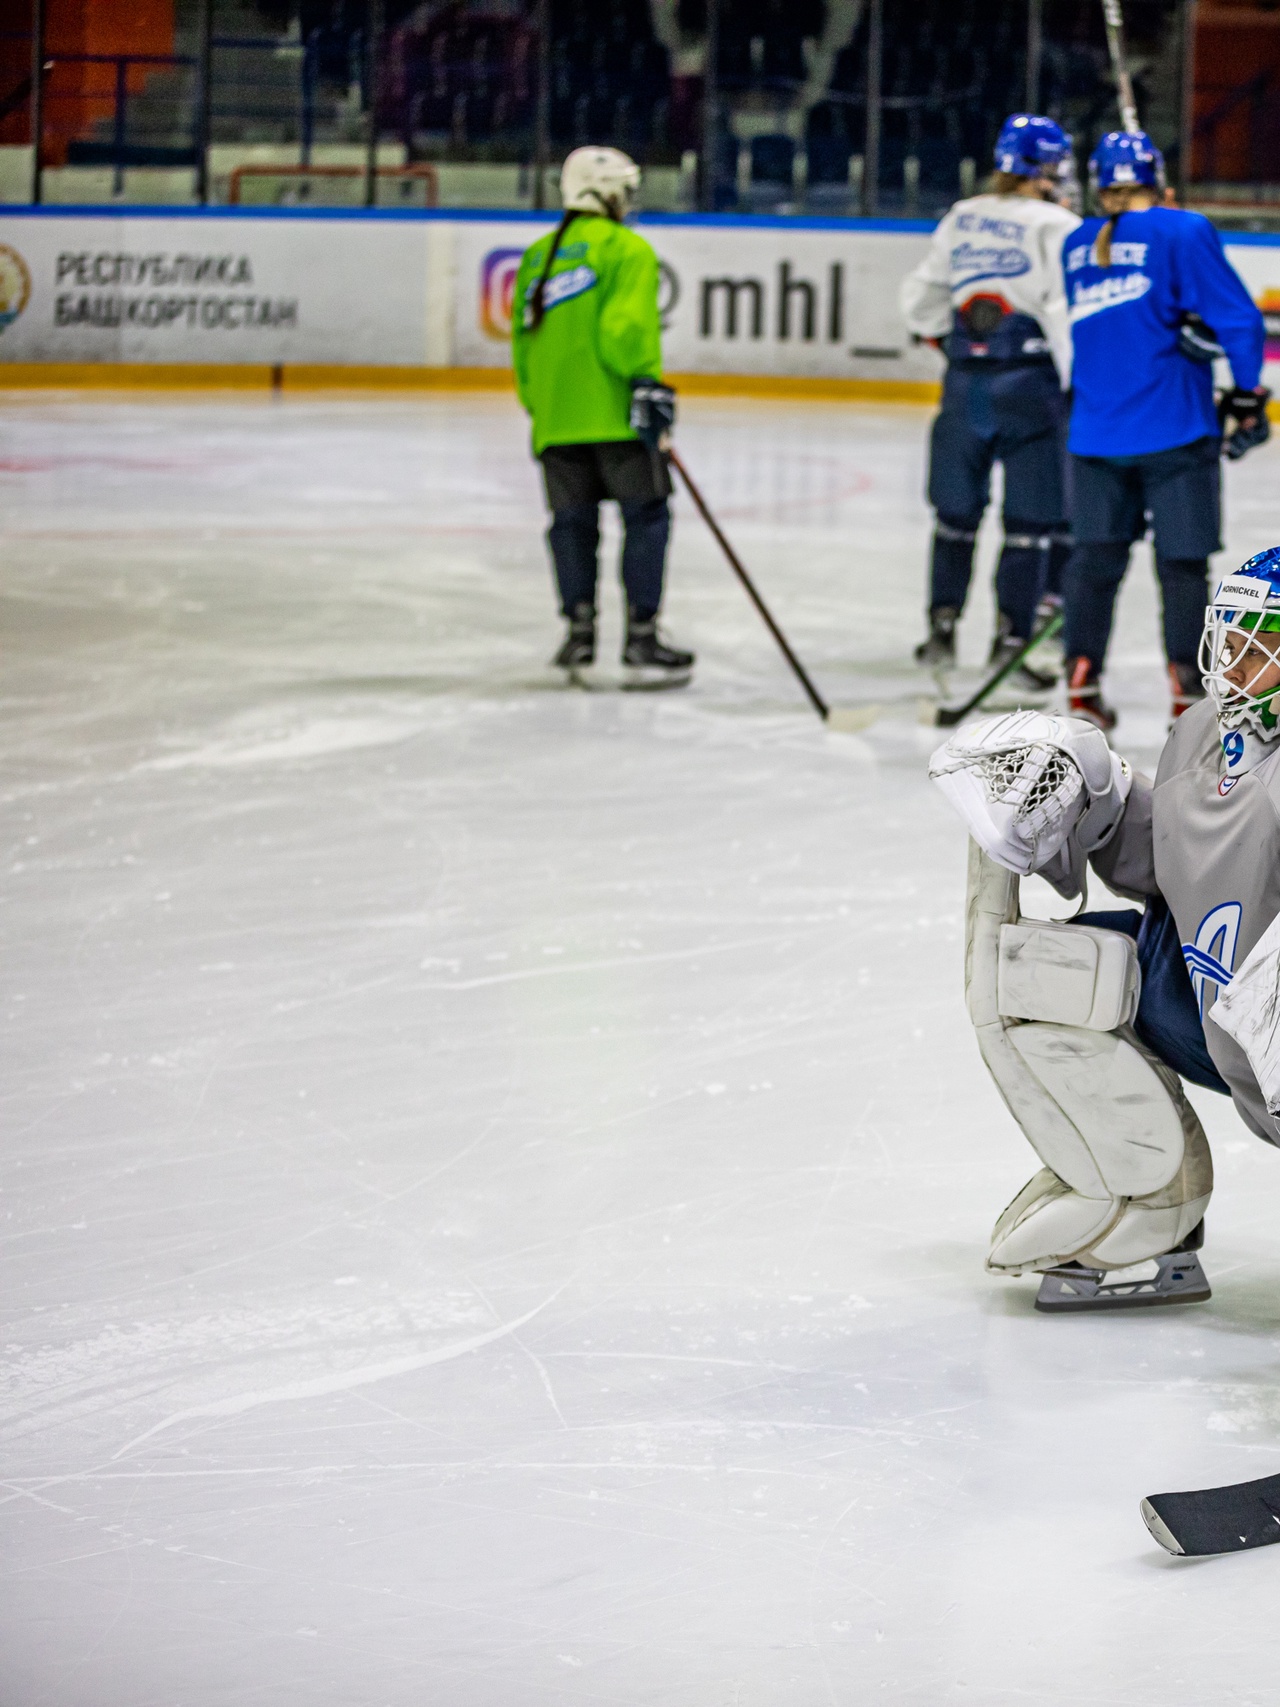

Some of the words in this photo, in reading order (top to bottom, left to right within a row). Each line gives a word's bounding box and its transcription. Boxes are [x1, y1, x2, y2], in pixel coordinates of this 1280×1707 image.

[56, 250, 254, 287] РЕСПУБЛИКА
[54, 292, 299, 330] БАШКОРТОСТАН
[658, 258, 902, 359] mhl_
[1223, 729, 1245, 768] 9
